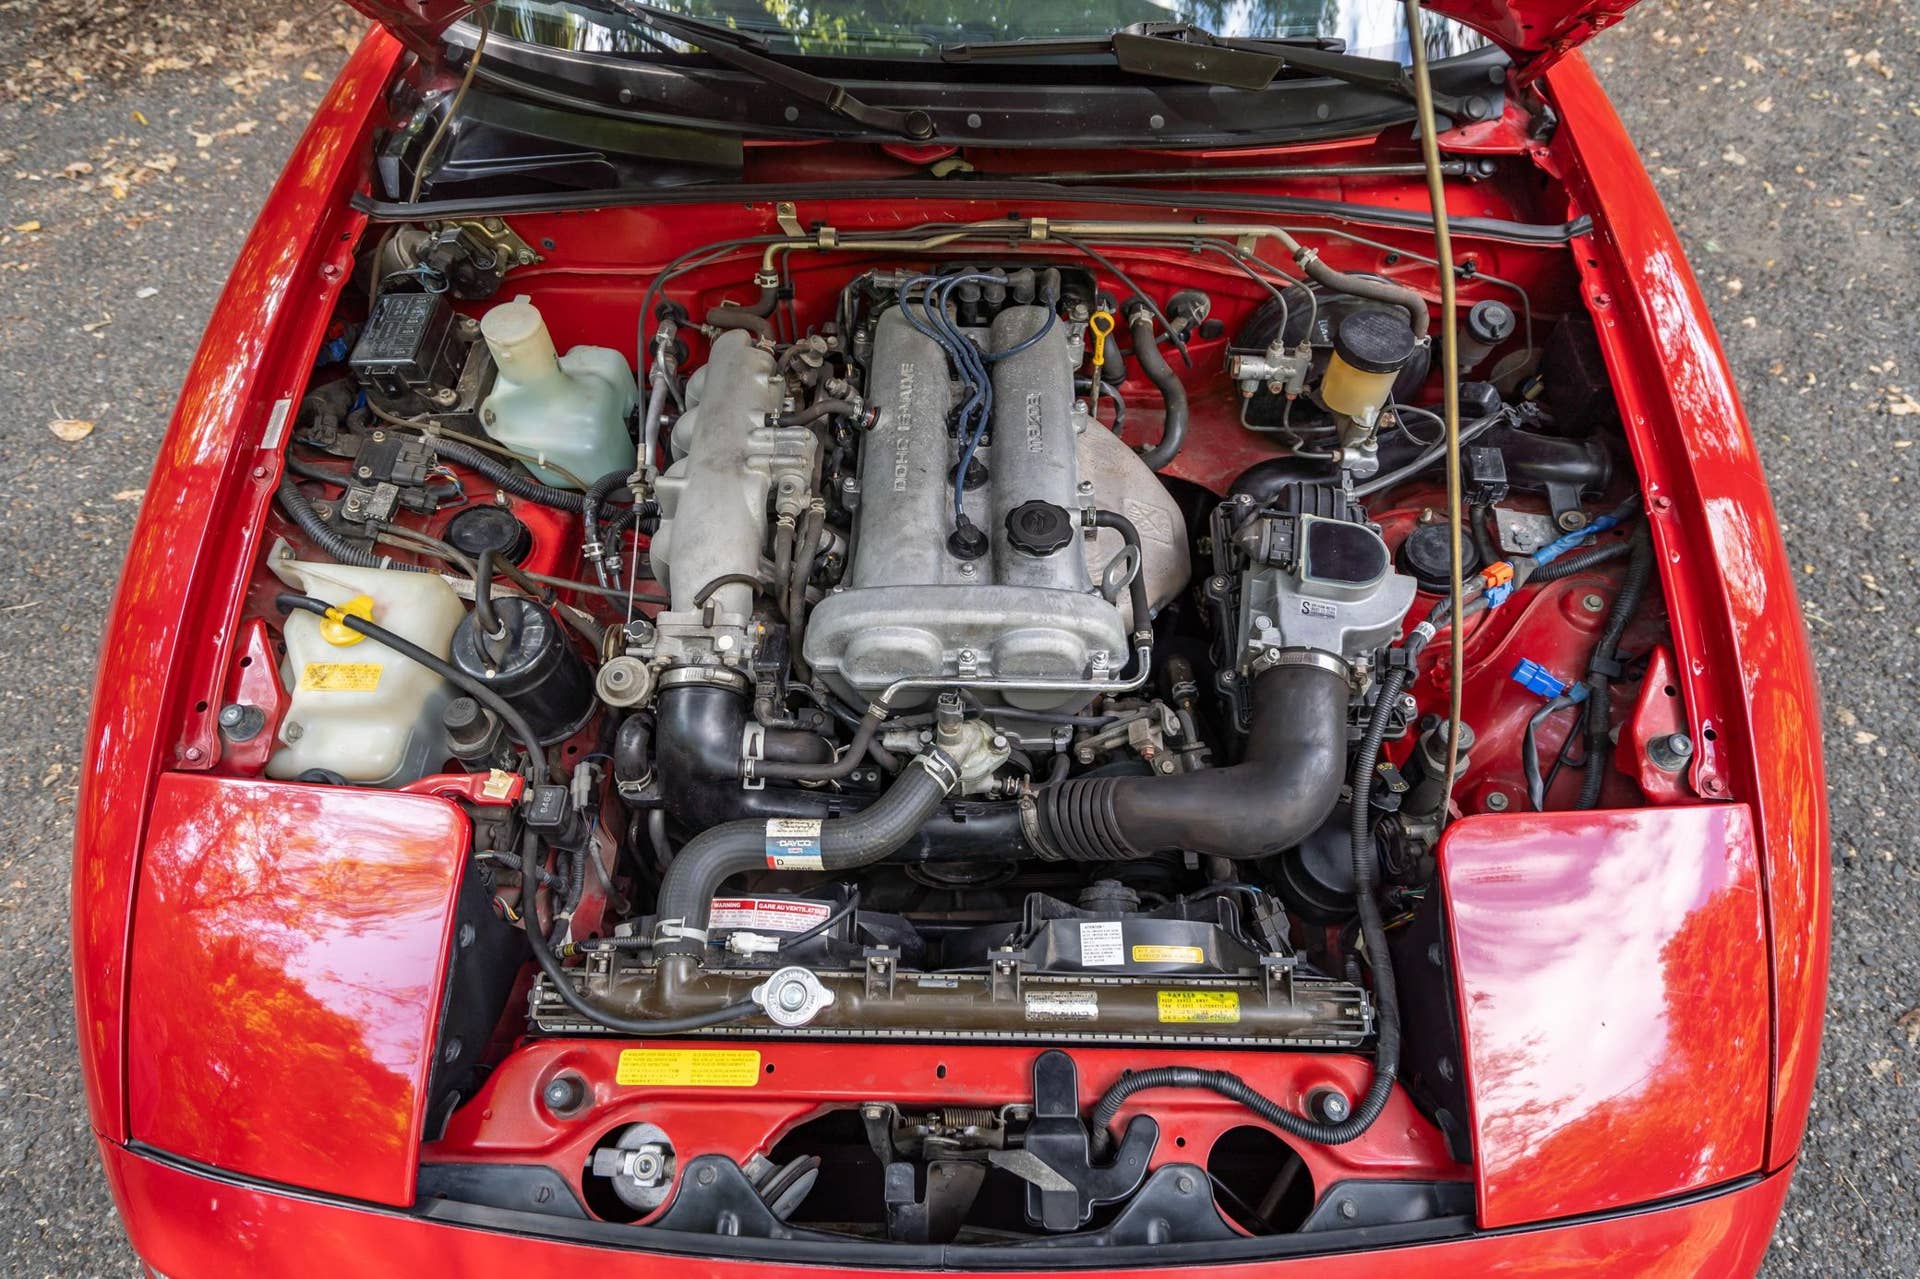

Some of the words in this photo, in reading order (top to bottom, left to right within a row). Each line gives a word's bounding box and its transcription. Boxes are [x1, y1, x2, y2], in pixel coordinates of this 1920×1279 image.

[895, 438, 910, 492] DOHC
[1301, 601, 1310, 614] S
[779, 839, 812, 847] DAYCO
[776, 858, 785, 866] D
